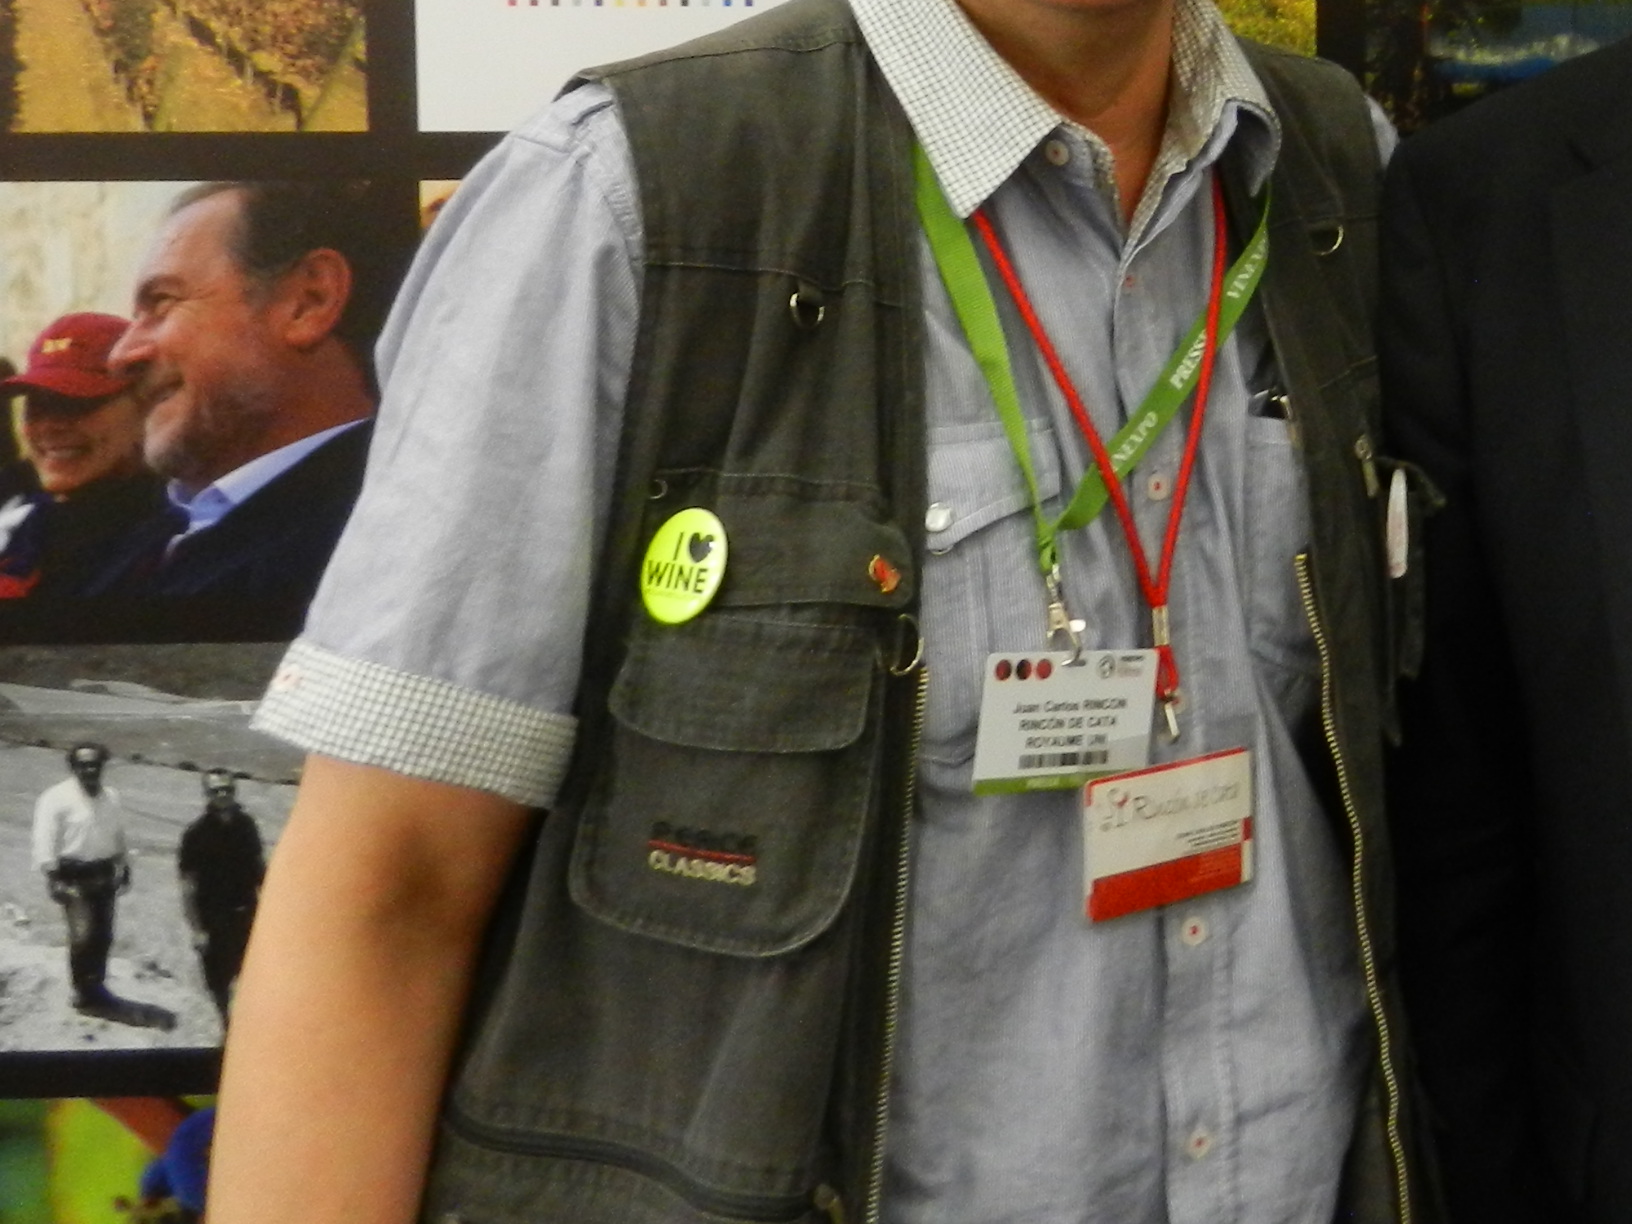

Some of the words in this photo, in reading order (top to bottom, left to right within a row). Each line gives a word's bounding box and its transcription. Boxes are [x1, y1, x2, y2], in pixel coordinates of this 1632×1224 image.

[672, 531, 685, 562] I
[646, 560, 708, 594] WINE
[648, 849, 758, 886] CLASSICS
